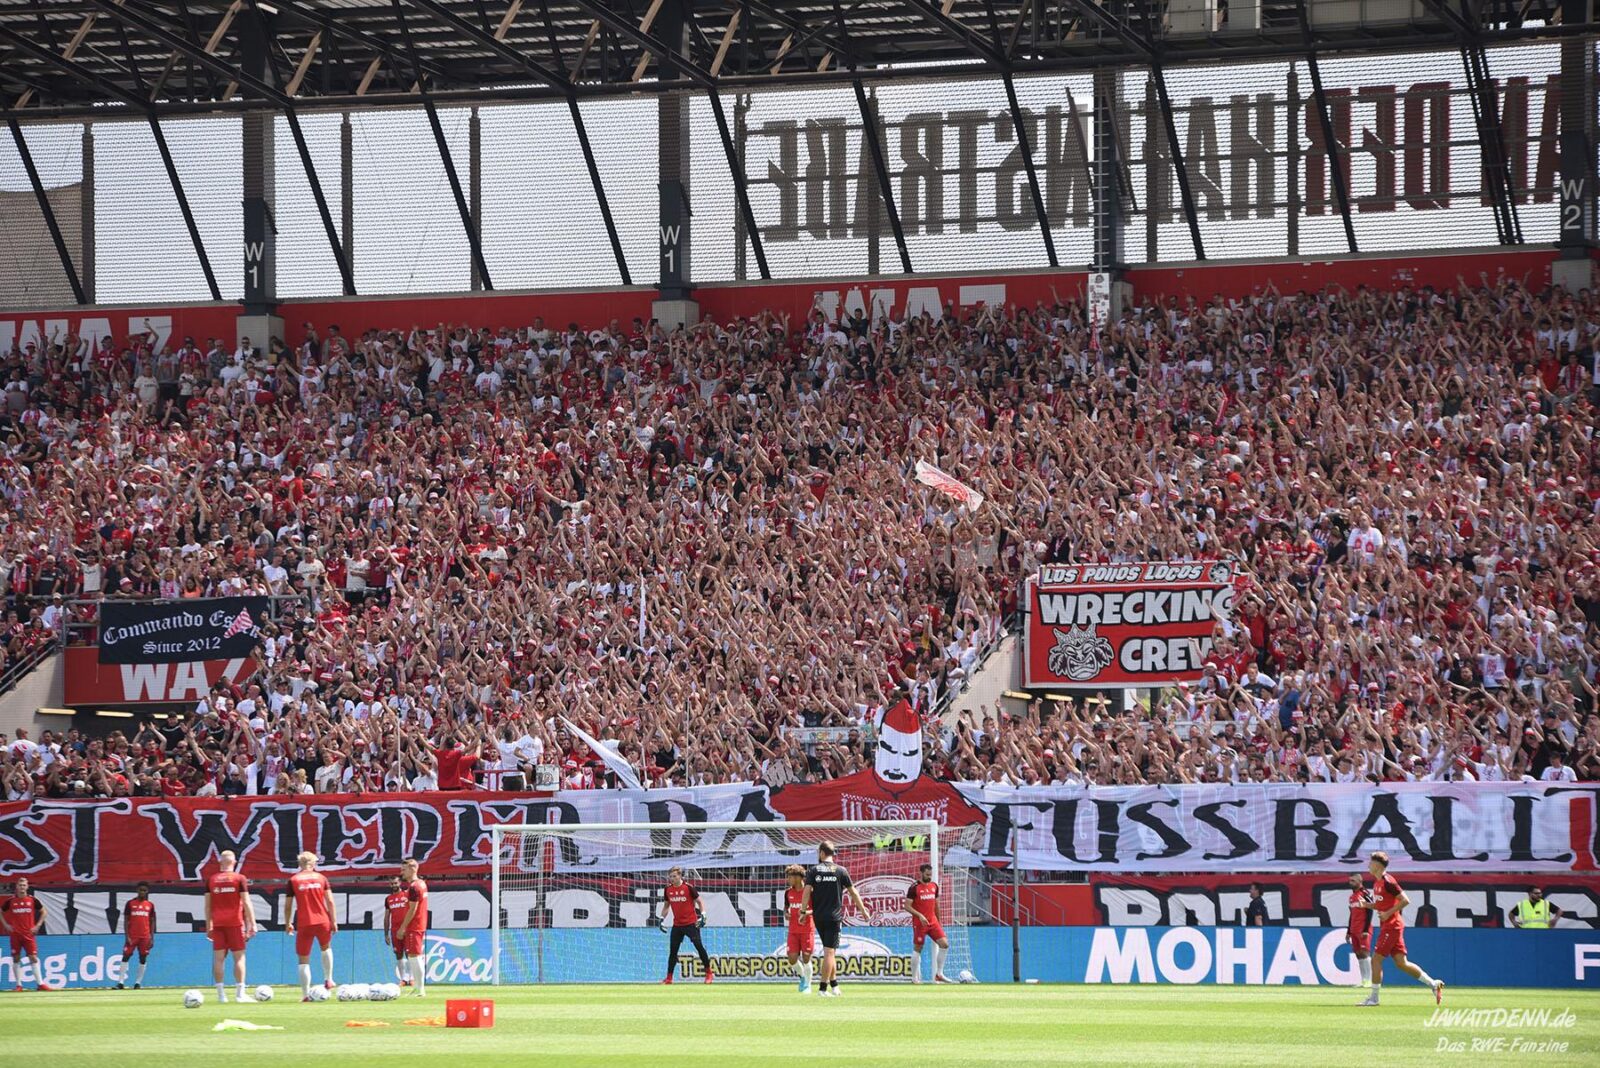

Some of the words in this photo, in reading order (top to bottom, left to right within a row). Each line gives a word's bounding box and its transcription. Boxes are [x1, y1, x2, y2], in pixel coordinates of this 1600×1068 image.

[1562, 178, 1584, 200] W
[1564, 204, 1582, 230] 2
[659, 225, 680, 246] W
[244, 241, 264, 262] W
[664, 249, 674, 273] 1
[248, 265, 258, 289] 1
[1043, 571, 1078, 583] LOS
[1144, 564, 1203, 580] LOCOS
[1039, 584, 1236, 625] WRECKING
[103, 611, 203, 645] Commando
[142, 640, 183, 654] Since
[186, 636, 221, 652] 2012
[980, 794, 1573, 864] FUSSBALL
[1084, 926, 1364, 986] MOHAG
